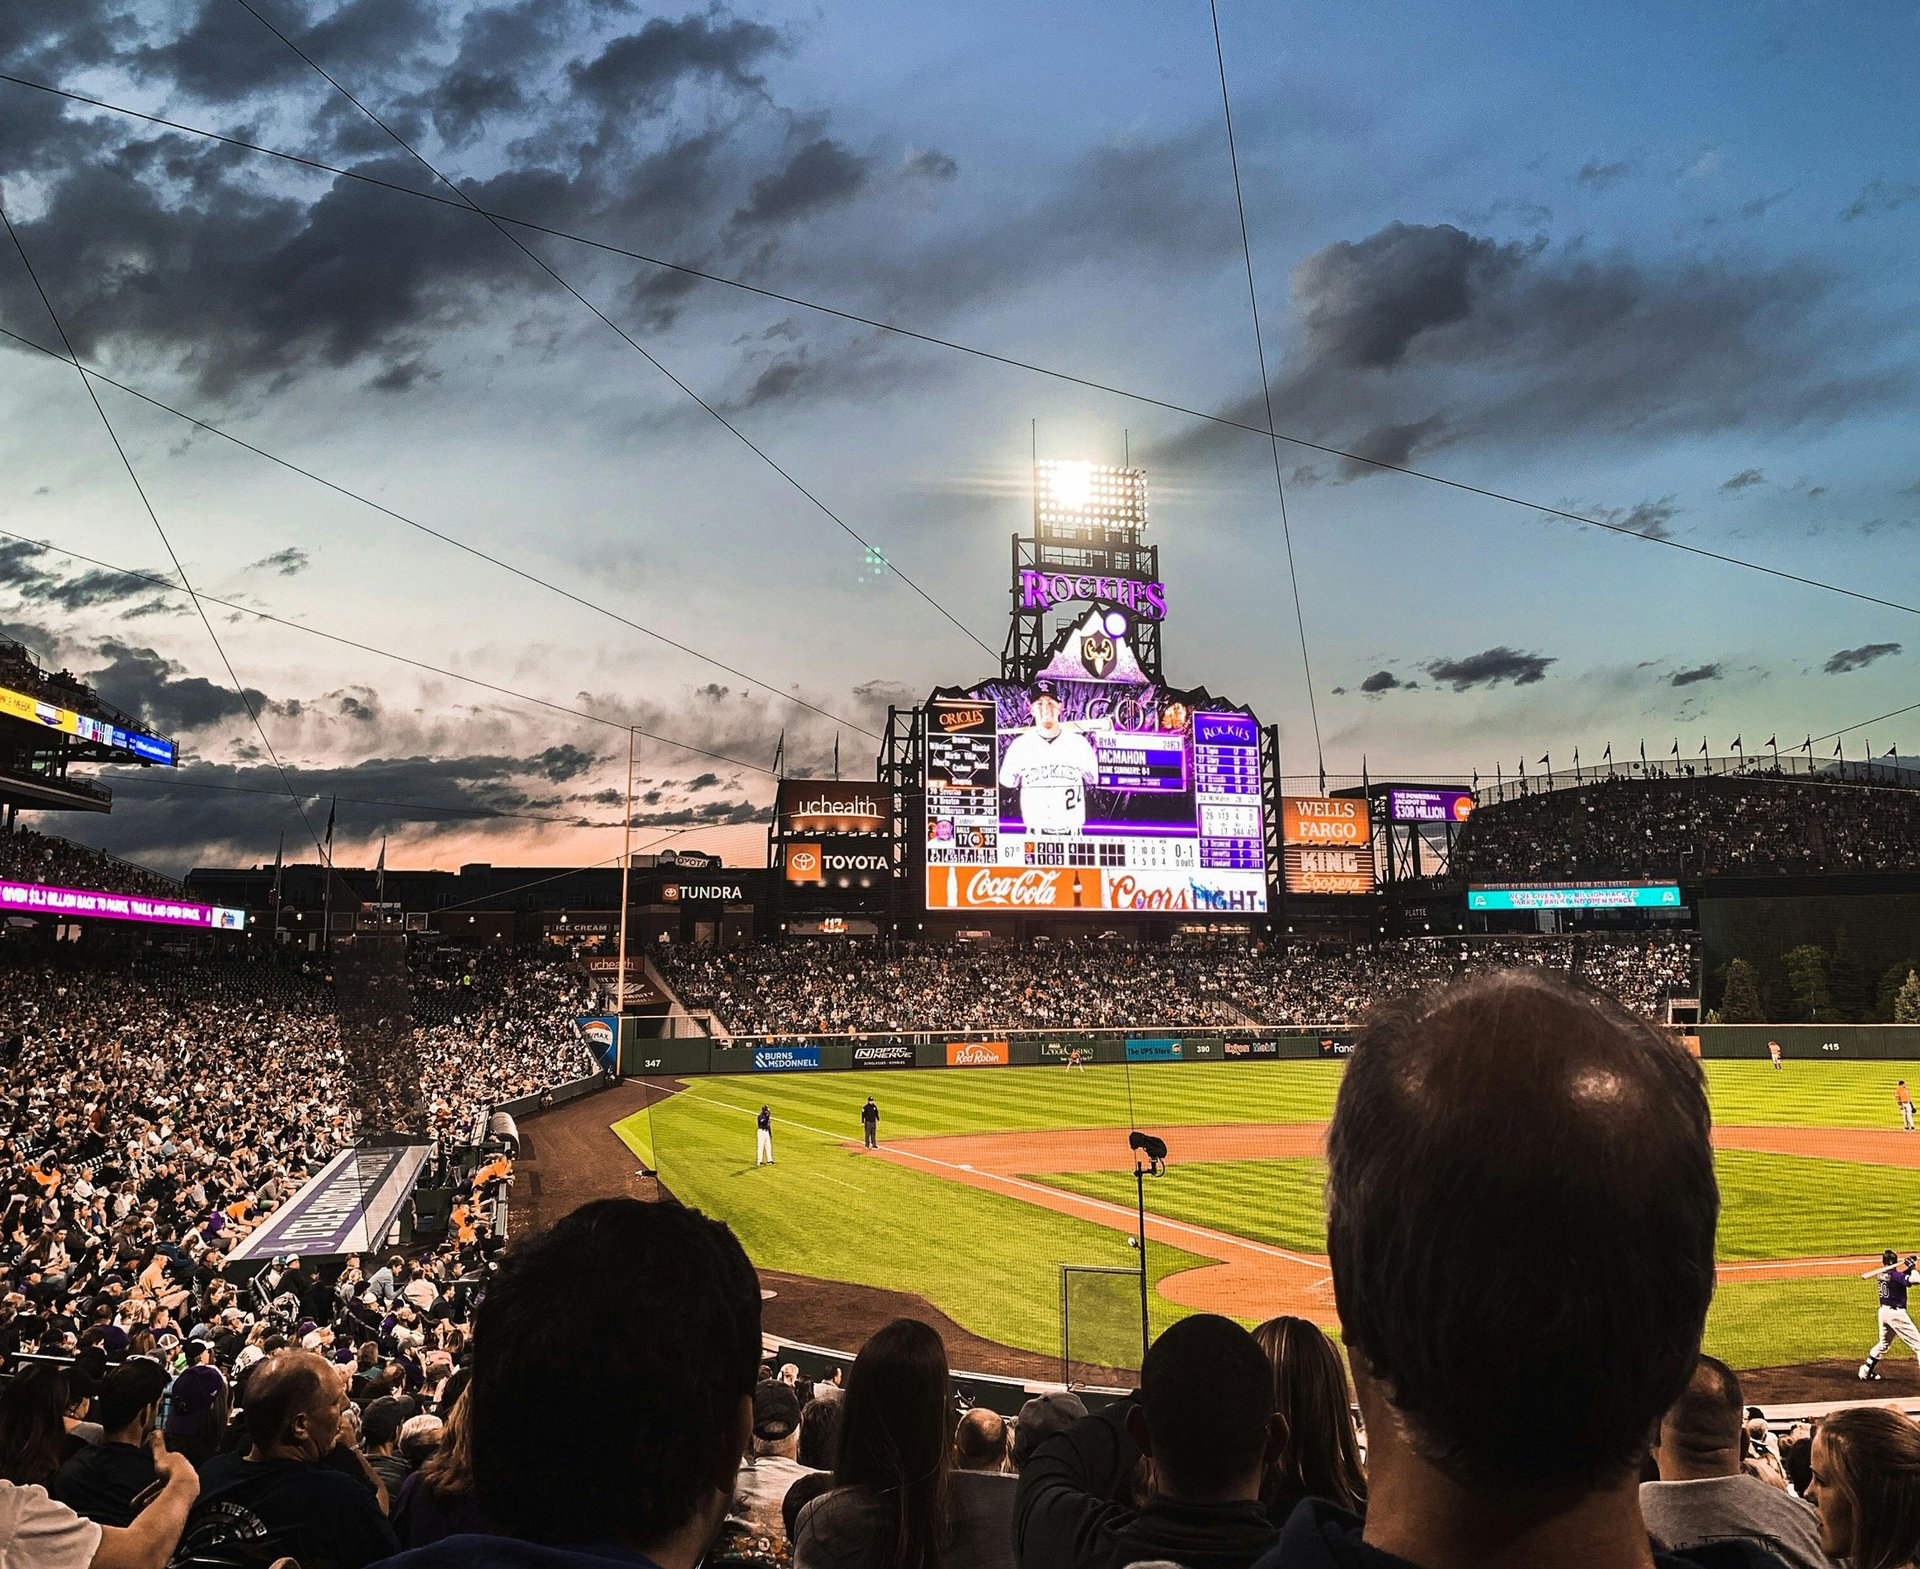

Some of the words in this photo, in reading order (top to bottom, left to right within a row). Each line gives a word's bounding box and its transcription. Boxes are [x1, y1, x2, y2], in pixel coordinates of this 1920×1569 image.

[1020, 569, 1168, 621] ROCKIES
[939, 709, 985, 727] ORIOLES
[1203, 725, 1250, 741] ROCKIES
[1098, 750, 1147, 765] MCMAHON
[799, 794, 877, 816] uchealth
[1295, 801, 1356, 818] WELLS
[1415, 805, 1446, 819] MILLION
[1298, 822, 1357, 838] FARGO
[958, 834, 968, 845] 17
[984, 835, 995, 845] 32
[822, 855, 889, 870] TOYOTA
[1300, 852, 1358, 872] KING
[966, 868, 1062, 905] Coca-Cola
[1301, 872, 1361, 891] Soopers
[679, 886, 742, 899] TUNDRA
[1109, 875, 1189, 910] Coors
[1192, 887, 1258, 911] LIGHT
[1405, 907, 1427, 917] PLATTE
[590, 957, 635, 971] ucheath
[1127, 1047, 1139, 1056] The
[1141, 1047, 1153, 1055] UPS
[1155, 1047, 1171, 1055] Store
[1196, 1045, 1210, 1053] 390
[1224, 1042, 1250, 1055] Exxon
[1252, 1041, 1277, 1053] Mobil
[1822, 1043, 1840, 1051] 415
[644, 1059, 661, 1068] 347
[764, 1052, 793, 1060] BURNS
[955, 1051, 973, 1063] Red
[974, 1049, 999, 1063] Robin
[277, 1211, 352, 1240] FIELD
